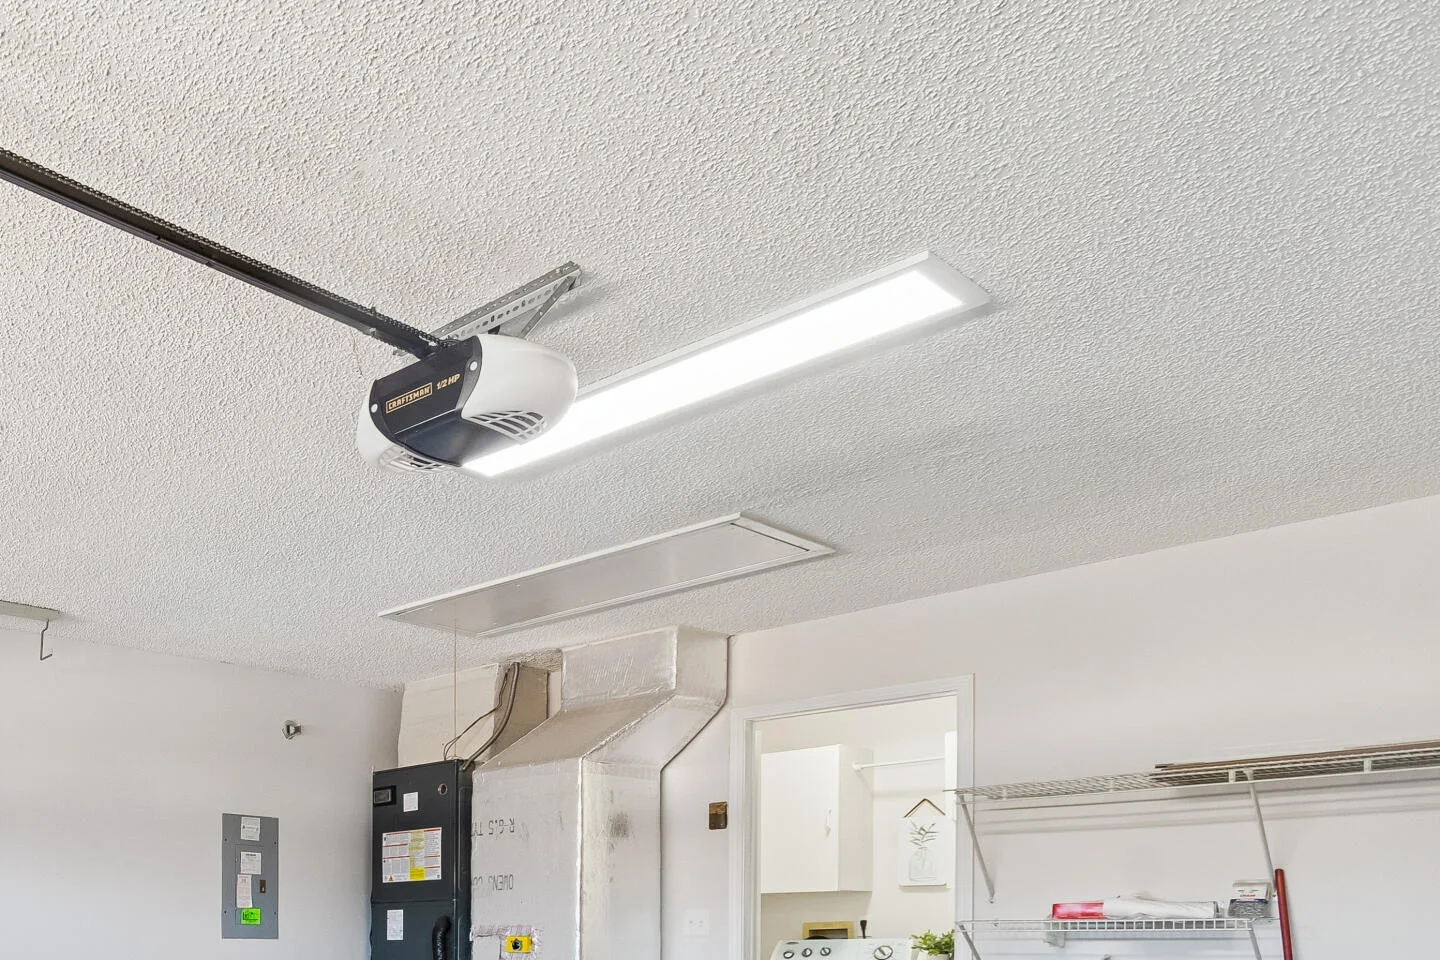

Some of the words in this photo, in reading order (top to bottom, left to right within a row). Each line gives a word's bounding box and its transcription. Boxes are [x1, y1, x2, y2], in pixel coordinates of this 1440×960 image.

[388, 386, 431, 410] CRAFTSMAN
[437, 380, 448, 390] 1/2
[448, 373, 461, 385] HP
